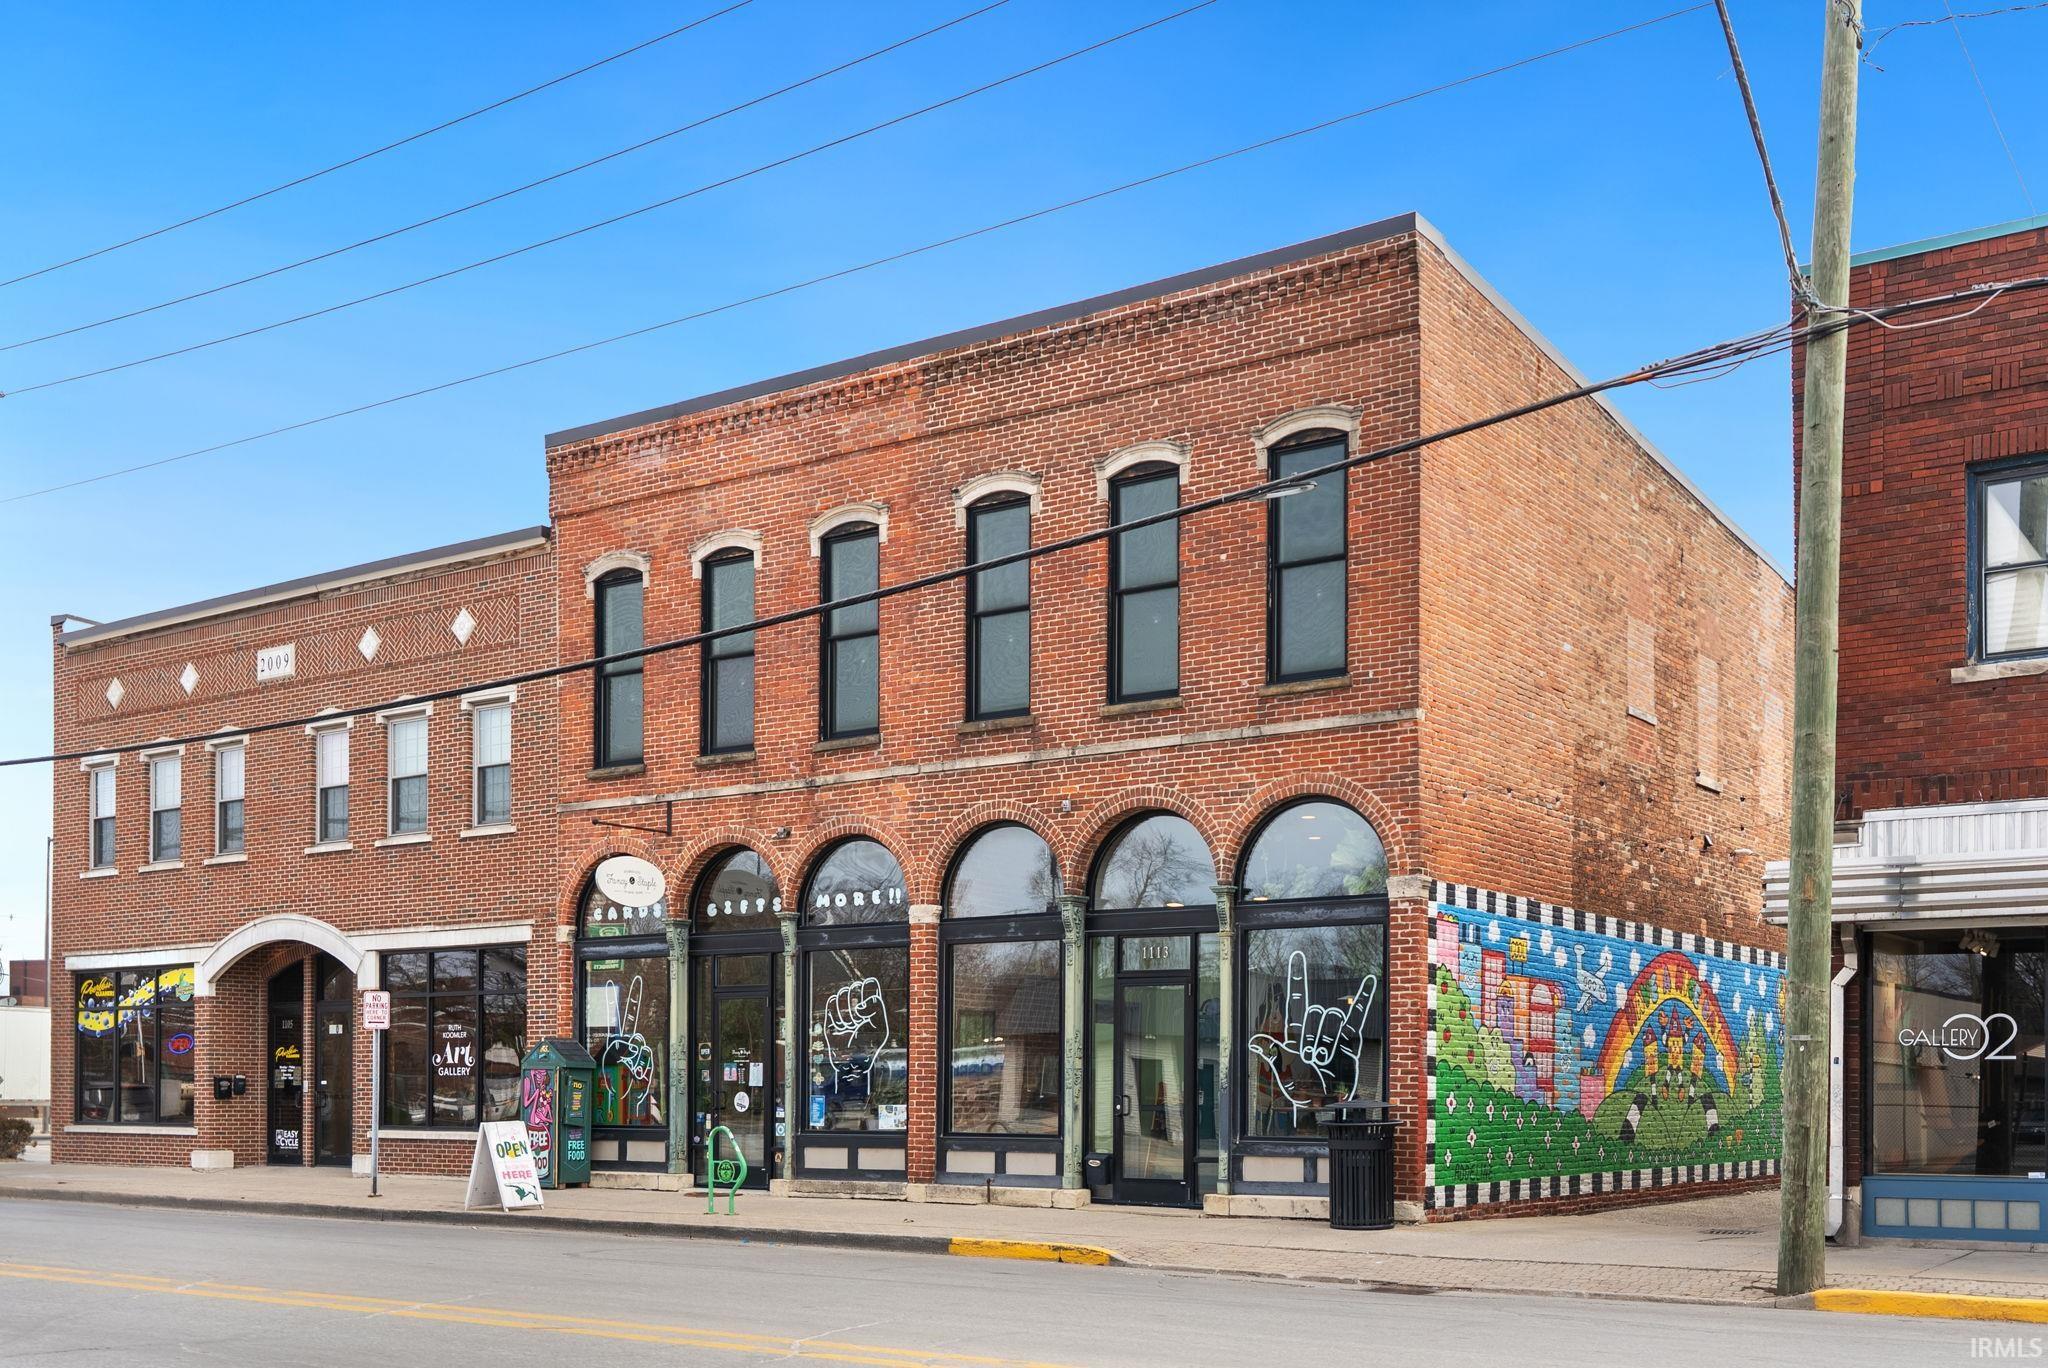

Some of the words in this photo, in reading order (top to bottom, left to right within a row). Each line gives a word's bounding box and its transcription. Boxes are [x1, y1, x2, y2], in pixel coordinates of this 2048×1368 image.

[261, 653, 289, 672] 2009
[594, 903, 662, 921] CARDS
[707, 896, 782, 917] GIFTS
[1143, 946, 1169, 959] 1113
[372, 994, 382, 1002] NO
[366, 1002, 388, 1010] PARKING
[1898, 1028, 1978, 1046] GALLERY
[432, 1041, 475, 1067] Art
[438, 1067, 471, 1076] GALLERY
[283, 1130, 299, 1138] EASY
[529, 1130, 548, 1147] FREE
[280, 1138, 299, 1147] CYCLE
[567, 1140, 585, 1150] FREE
[496, 1140, 529, 1158] OPEN
[567, 1150, 585, 1161] FOOD
[502, 1170, 533, 1180] HERE
